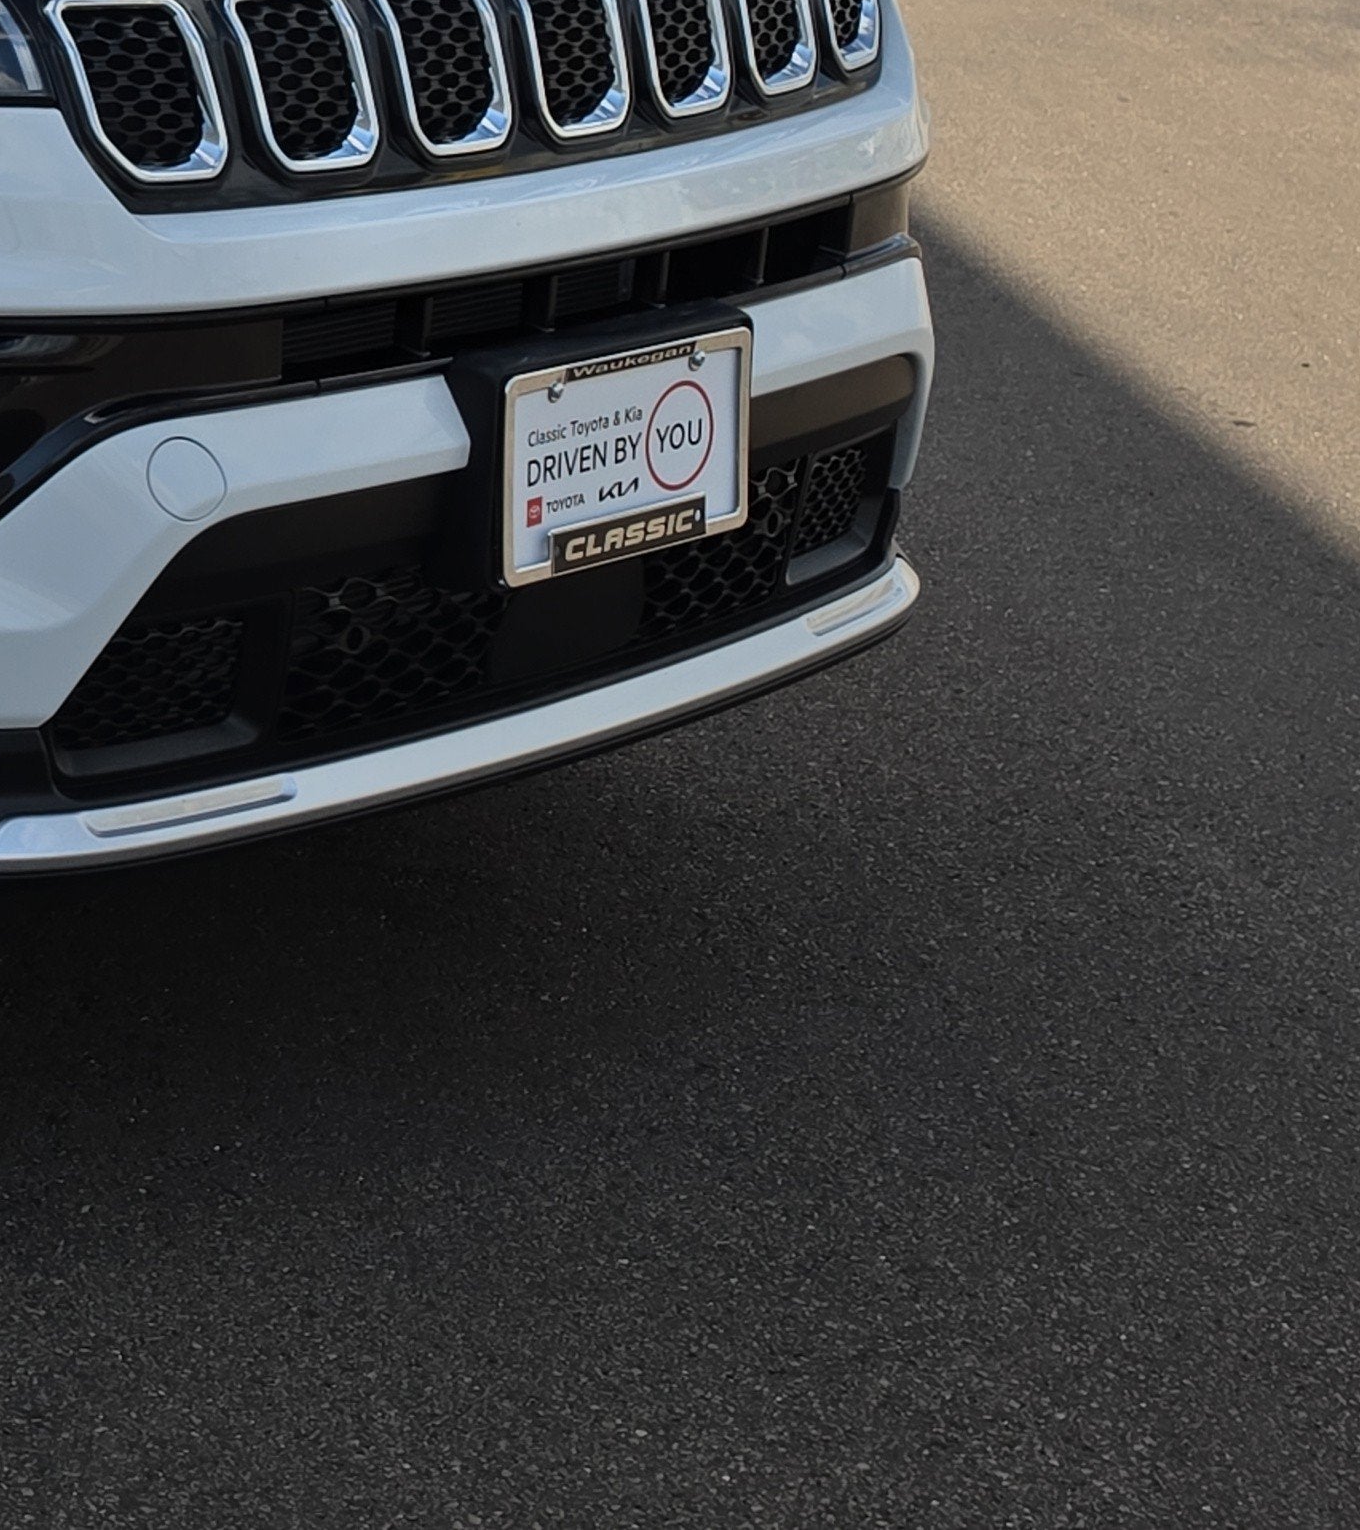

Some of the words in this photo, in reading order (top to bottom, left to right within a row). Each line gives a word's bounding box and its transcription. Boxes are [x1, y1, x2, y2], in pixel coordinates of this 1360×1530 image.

[572, 344, 692, 378] Waukegan
[528, 423, 567, 447] Classic
[570, 414, 609, 437] Toyota
[613, 410, 621, 426] &
[624, 406, 643, 423] Kia
[527, 441, 607, 488] DRIVEN
[615, 431, 642, 465] BY
[656, 418, 703, 454] YOU
[546, 493, 585, 514] TOYOTA
[564, 508, 694, 562] CLASSIC
